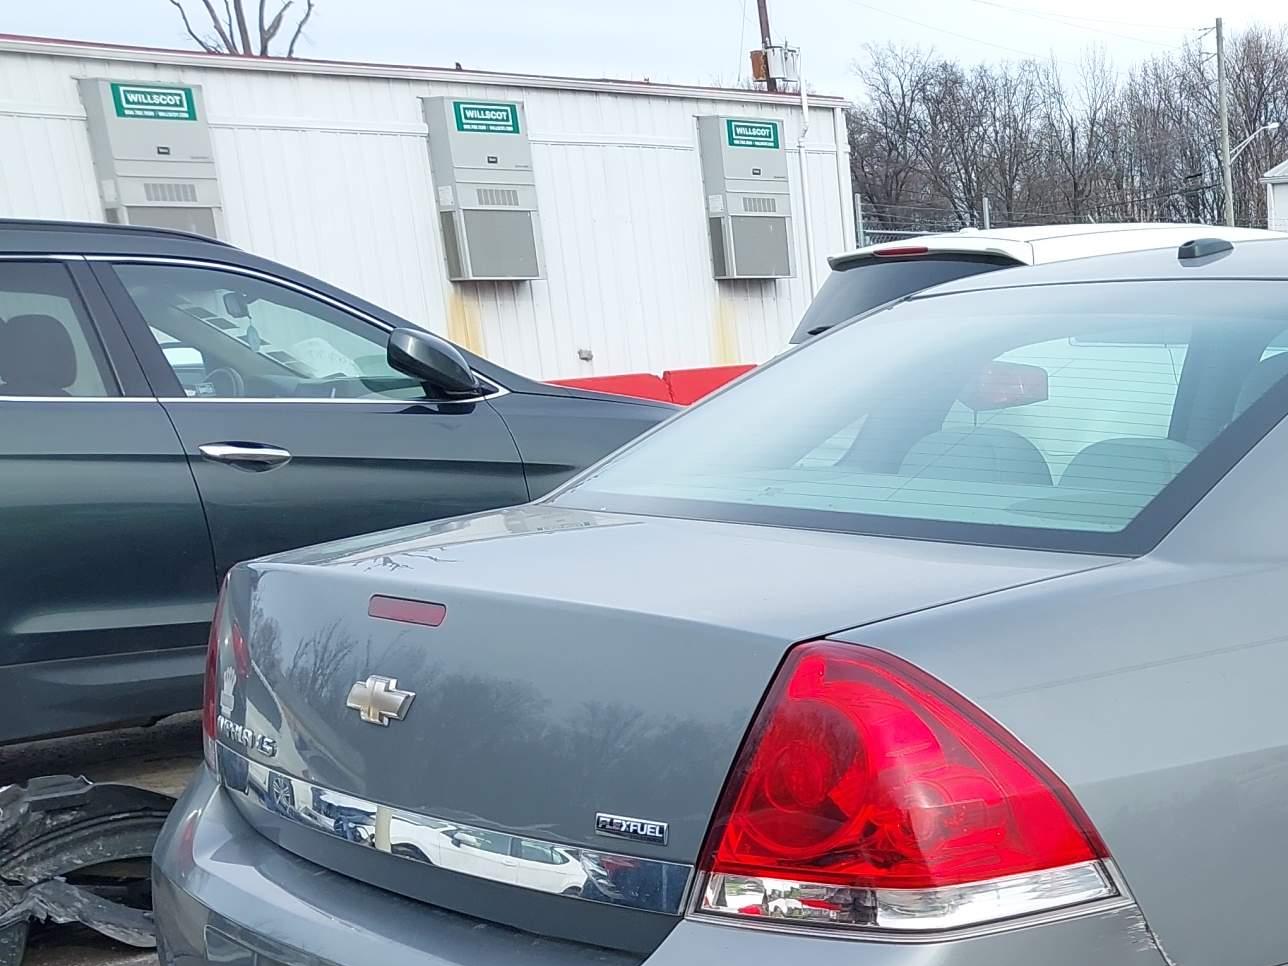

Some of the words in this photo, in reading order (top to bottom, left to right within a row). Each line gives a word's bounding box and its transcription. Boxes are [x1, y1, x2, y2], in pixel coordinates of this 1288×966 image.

[125, 92, 181, 105] WILLSCOT
[465, 109, 507, 120] WILLSCOT
[736, 127, 770, 136] WILLSCOT
[599, 816, 663, 837] FLEXFUEL
